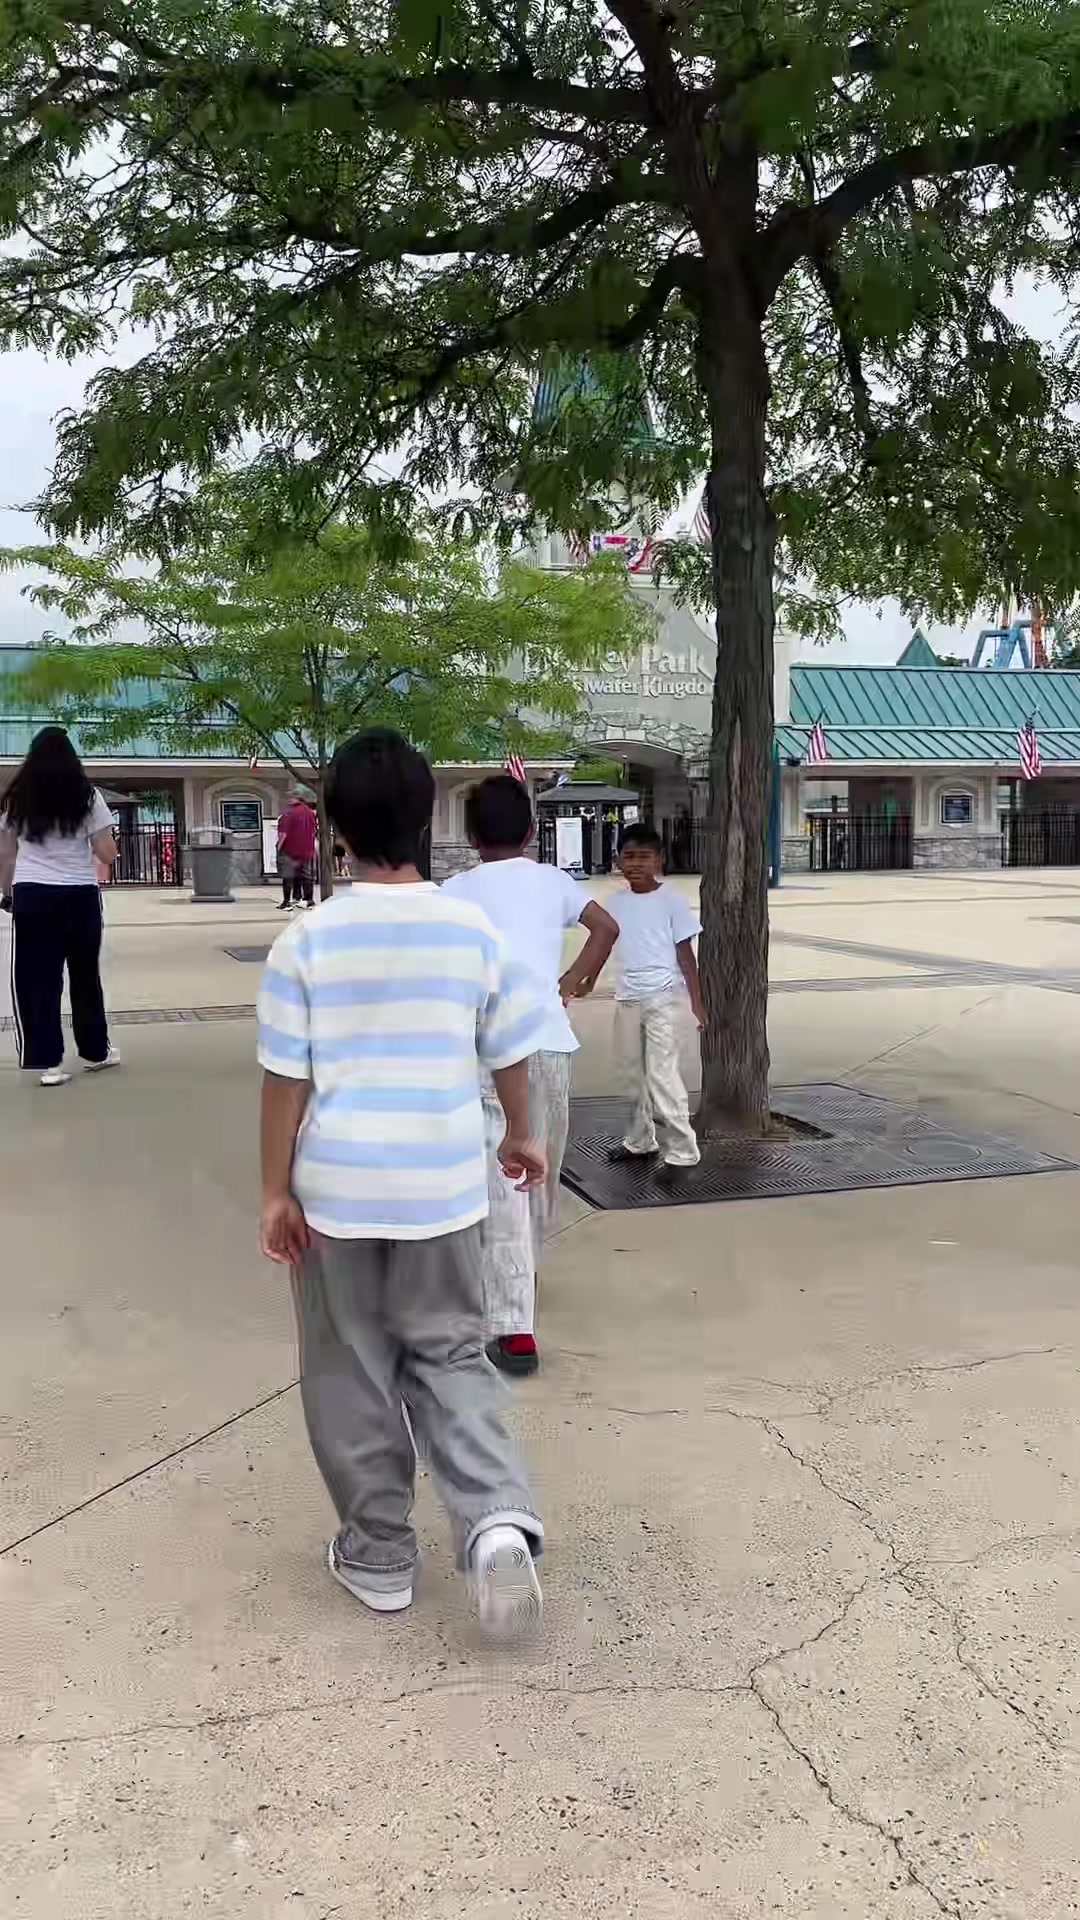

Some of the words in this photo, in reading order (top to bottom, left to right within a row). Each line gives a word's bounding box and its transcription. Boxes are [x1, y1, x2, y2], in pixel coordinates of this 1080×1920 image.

[640, 643, 712, 680] Park
[582, 678, 639, 695] water
[642, 674, 708, 699] Kingdo
